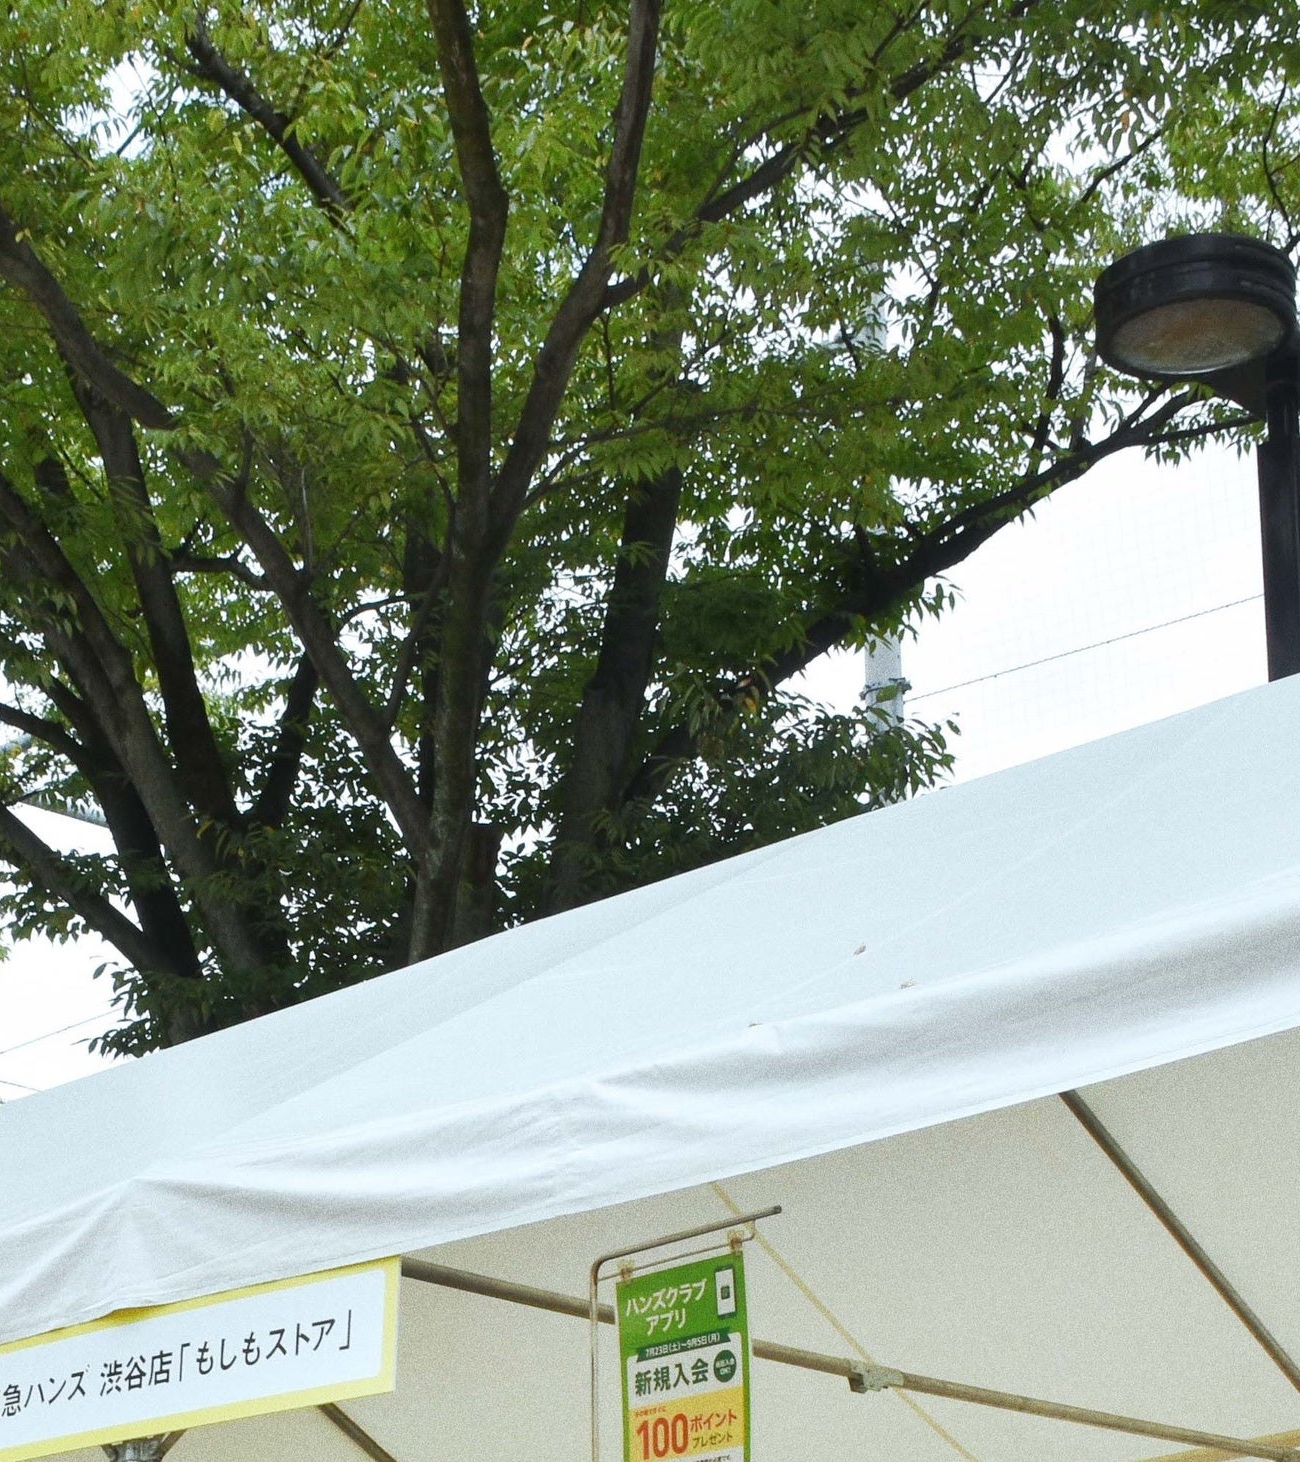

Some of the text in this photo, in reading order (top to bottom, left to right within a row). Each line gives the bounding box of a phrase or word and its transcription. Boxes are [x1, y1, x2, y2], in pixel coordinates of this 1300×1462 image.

[624, 1279, 707, 1317] ハンズクラブ
[645, 1308, 687, 1338] アプリ
[99, 1309, 354, 1398] 渋谷店「もしもストア」
[634, 1358, 710, 1397] 新規入会
[636, 1412, 689, 1461] 100
[689, 1407, 738, 1432] ポイント
[691, 1432, 733, 1450] プレゼント
